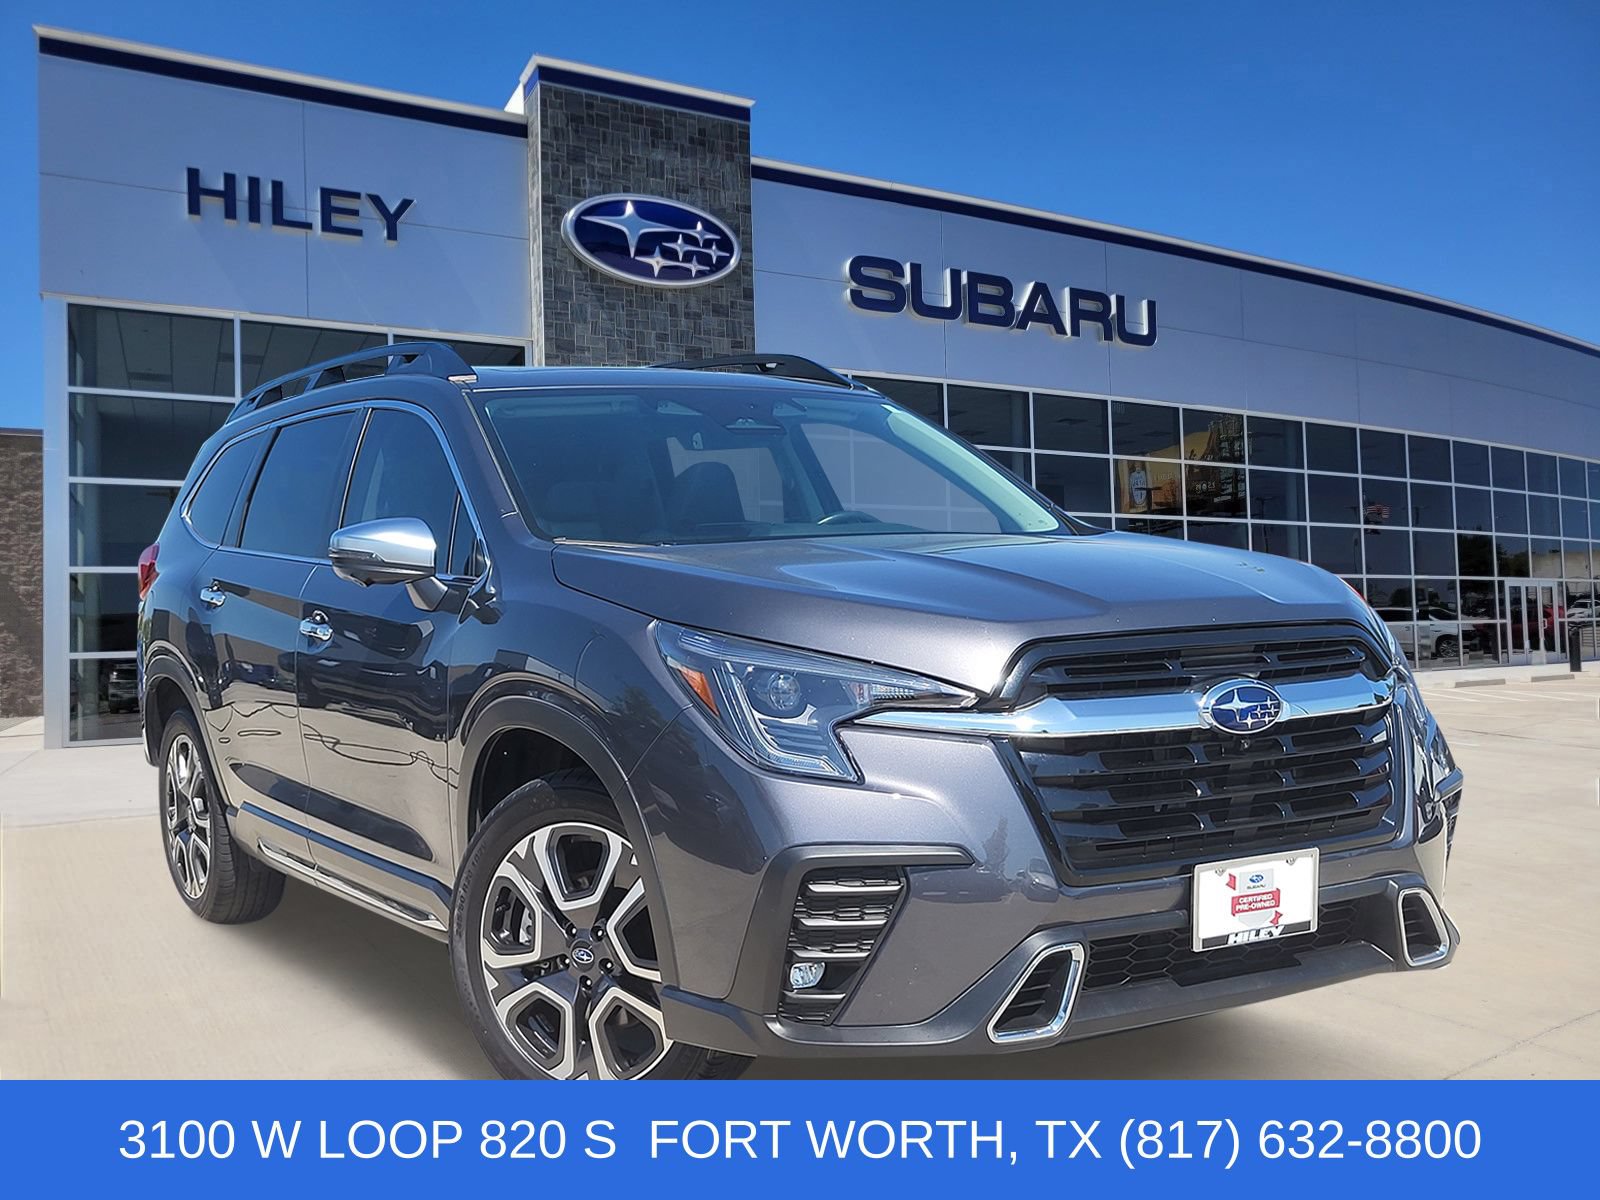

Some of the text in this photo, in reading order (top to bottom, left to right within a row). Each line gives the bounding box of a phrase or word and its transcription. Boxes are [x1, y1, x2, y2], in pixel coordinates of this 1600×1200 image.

[187, 167, 415, 242] HILEY
[848, 255, 1158, 347] SUBARU
[1235, 900, 1276, 912] PRE-OWNED
[1238, 893, 1274, 904] CERTIFIED
[1228, 925, 1284, 945] HILEY
